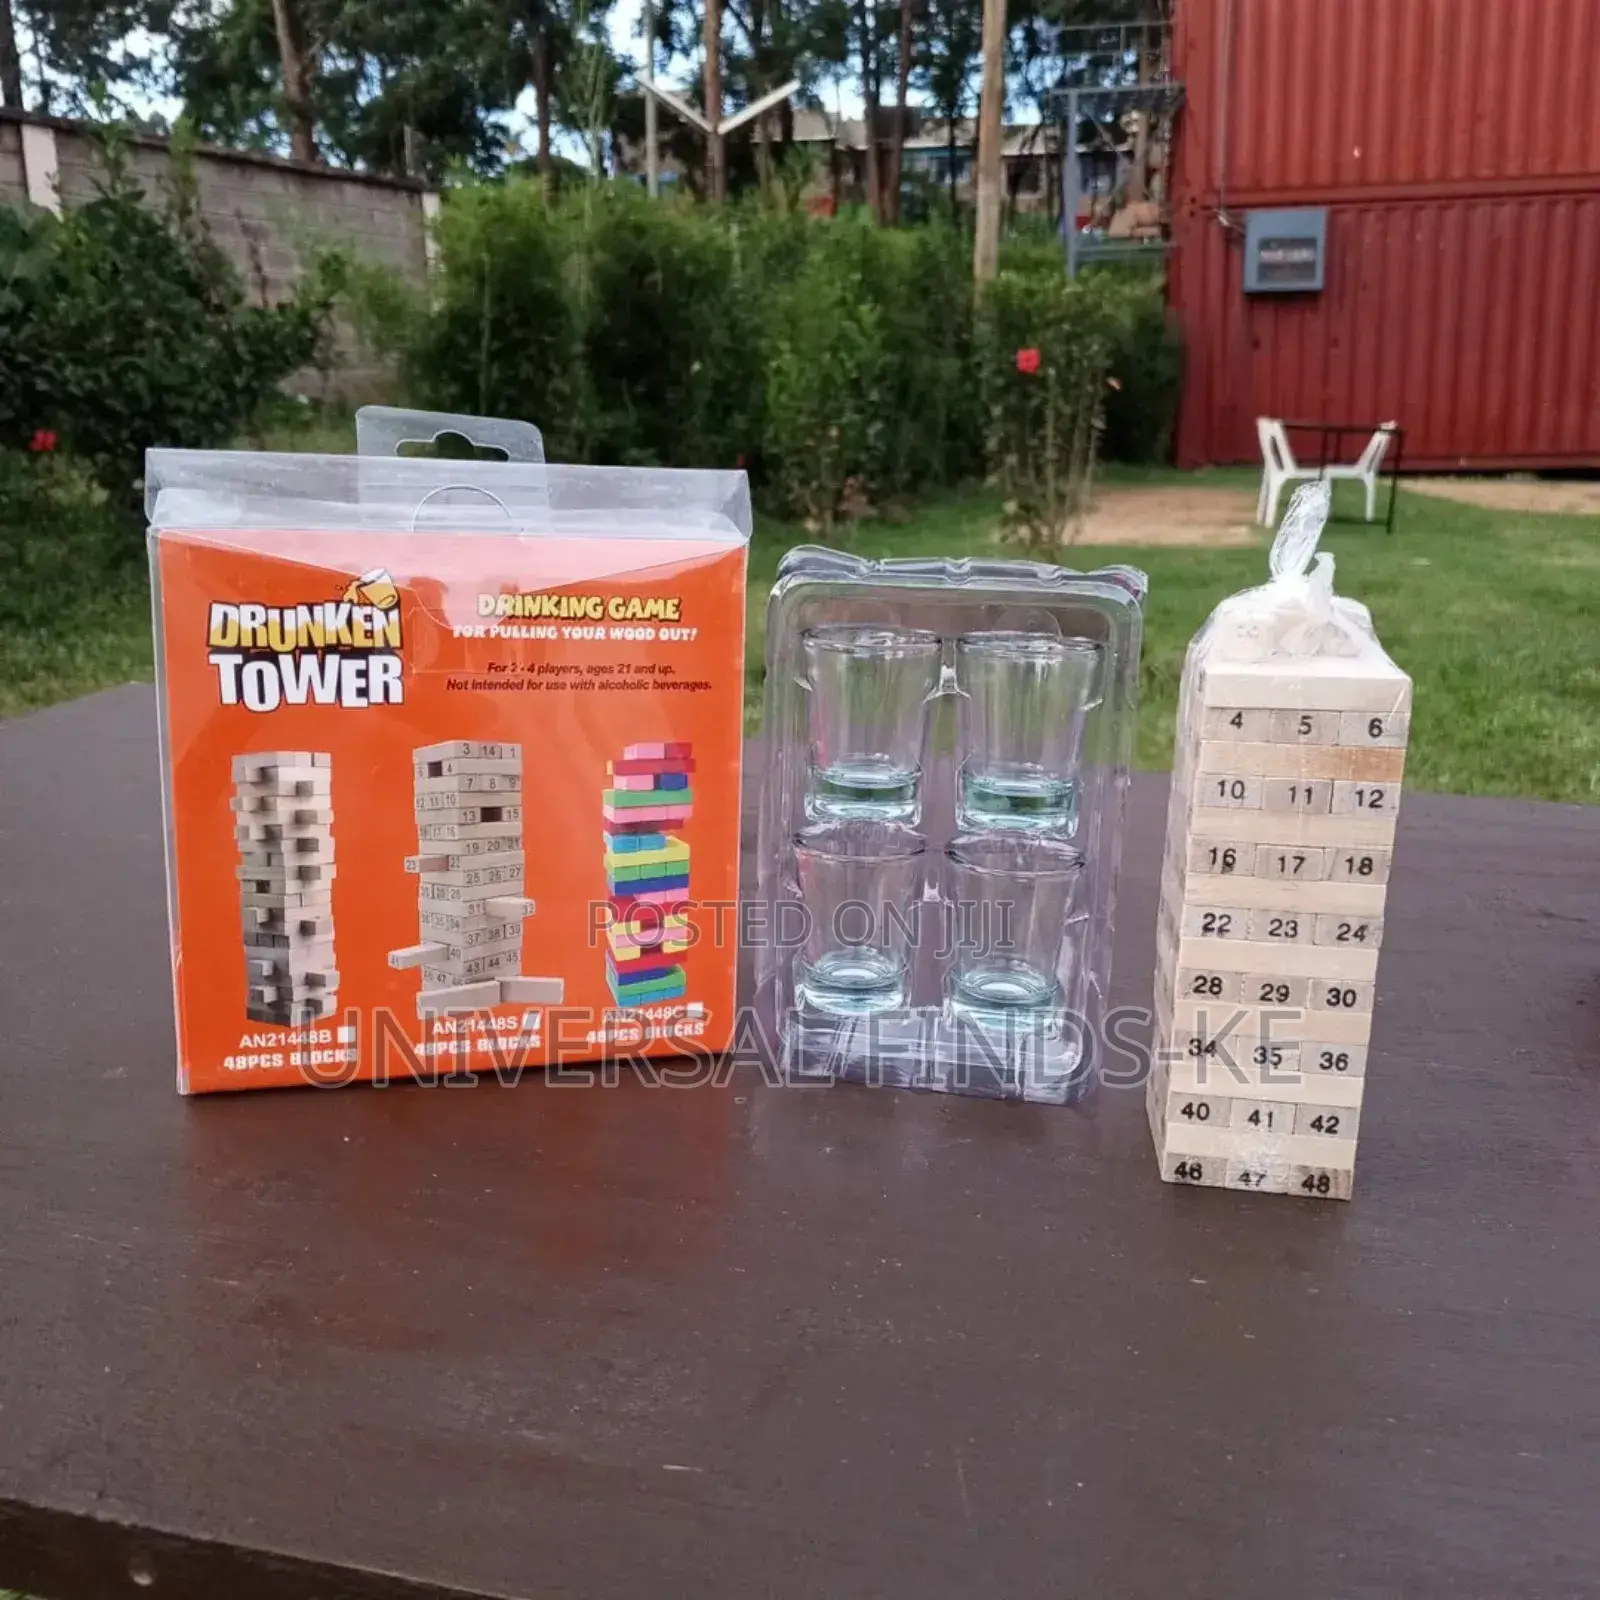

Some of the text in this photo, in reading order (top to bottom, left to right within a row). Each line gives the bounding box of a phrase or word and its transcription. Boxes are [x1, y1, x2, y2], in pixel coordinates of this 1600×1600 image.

[477, 593, 682, 621] DRINKING GAME
[208, 601, 402, 652] DRUNKEN
[453, 625, 697, 641] FOR PULLING YOUR WOOD OUT!
[488, 662, 507, 674] For
[511, 663, 518, 673] 2
[527, 664, 535, 674] 4
[537, 663, 583, 677] players,
[586, 665, 614, 677] ages
[617, 664, 631, 674] 21
[634, 664, 656, 674] and
[658, 665, 676, 677] up.
[208, 652, 404, 712] TOWER
[446, 679, 468, 690] Not
[527, 679, 542, 690] for
[545, 681, 566, 691] use
[570, 679, 595, 691] with
[598, 679, 649, 691] alcoholic
[652, 679, 712, 693] beverages.
[1229, 711, 1383, 738] 4 5 6
[463, 743, 470, 755] 3
[465, 778, 473, 789] 7
[1217, 780, 1385, 809] 10 11 12
[462, 809, 519, 822] 13 15
[466, 843, 479, 853] 19
[487, 841, 500, 851] 20
[1209, 847, 1373, 876] 16 17 18
[468, 933, 480, 945] 37
[1202, 913, 1368, 942] 22 23 24
[467, 962, 480, 974] 43
[488, 958, 500, 969] 44
[1193, 976, 1356, 1008] 28 29 30
[239, 1029, 332, 1048] AN21448B
[223, 1048, 357, 1070] 48PCS BLOCKS
[1188, 1038, 1349, 1071] 34 35 36
[1181, 1102, 1340, 1134] 40 41 42
[1174, 1162, 1330, 1193] 46 47 48
